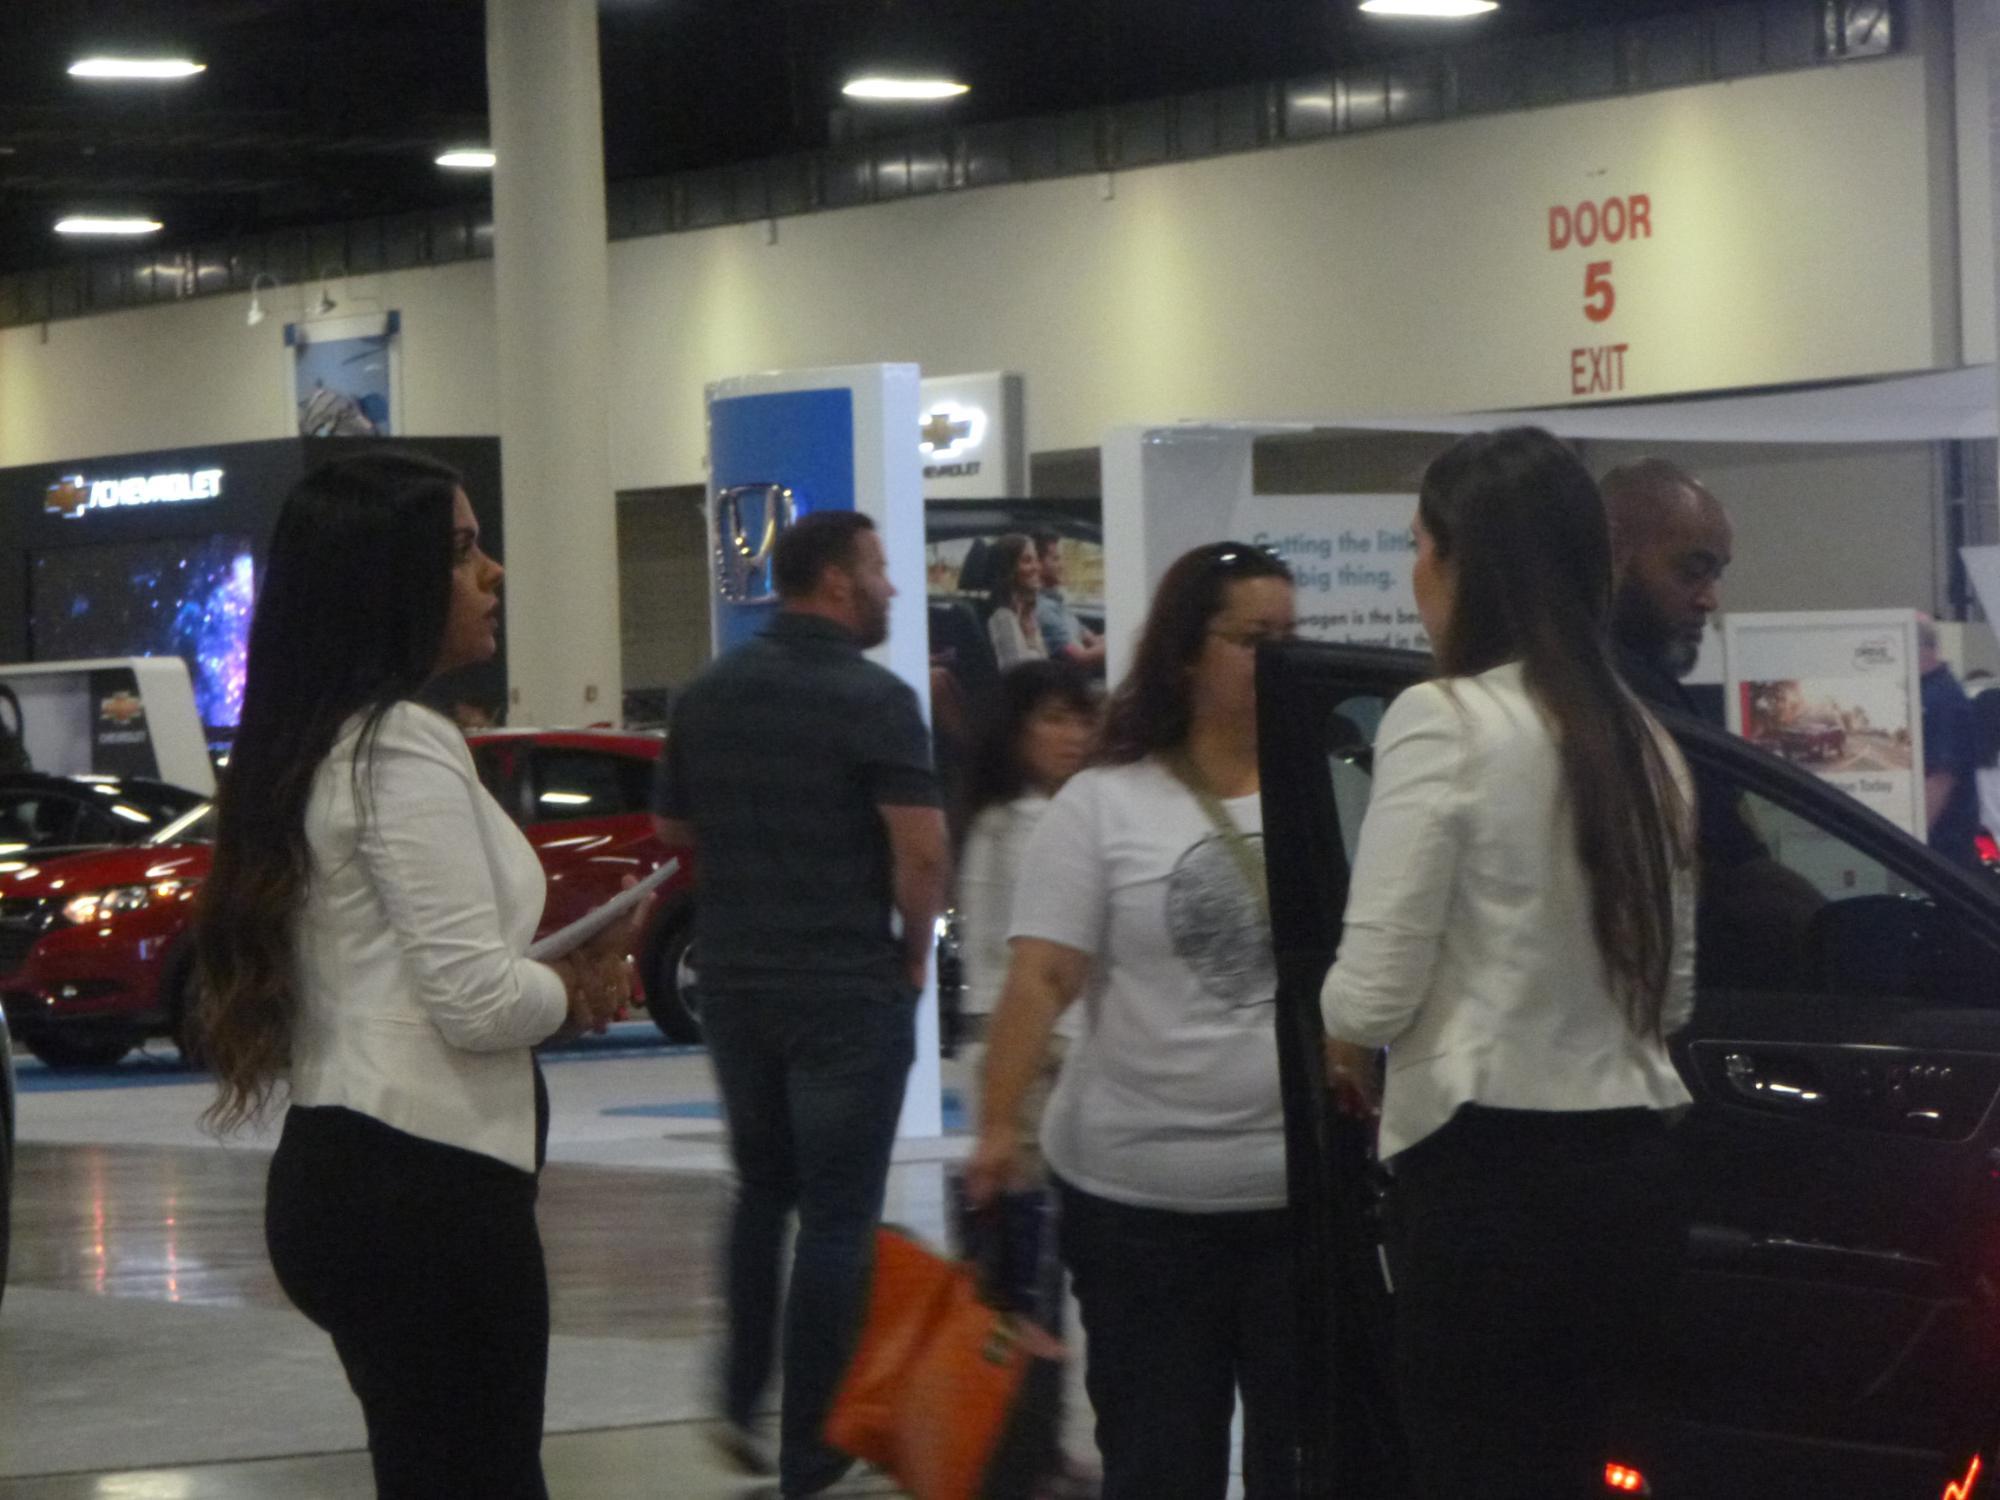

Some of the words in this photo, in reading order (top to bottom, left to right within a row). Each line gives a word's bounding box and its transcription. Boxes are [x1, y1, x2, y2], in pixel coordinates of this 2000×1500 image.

[1549, 194, 1652, 251] DOOR
[1584, 260, 1616, 323] 5
[1571, 343, 1629, 395] EXIT
[97, 470, 223, 508] CHEVROLET
[1253, 532, 1331, 559] Gtting
[1338, 531, 1371, 552] the
[1297, 565, 1331, 592] big
